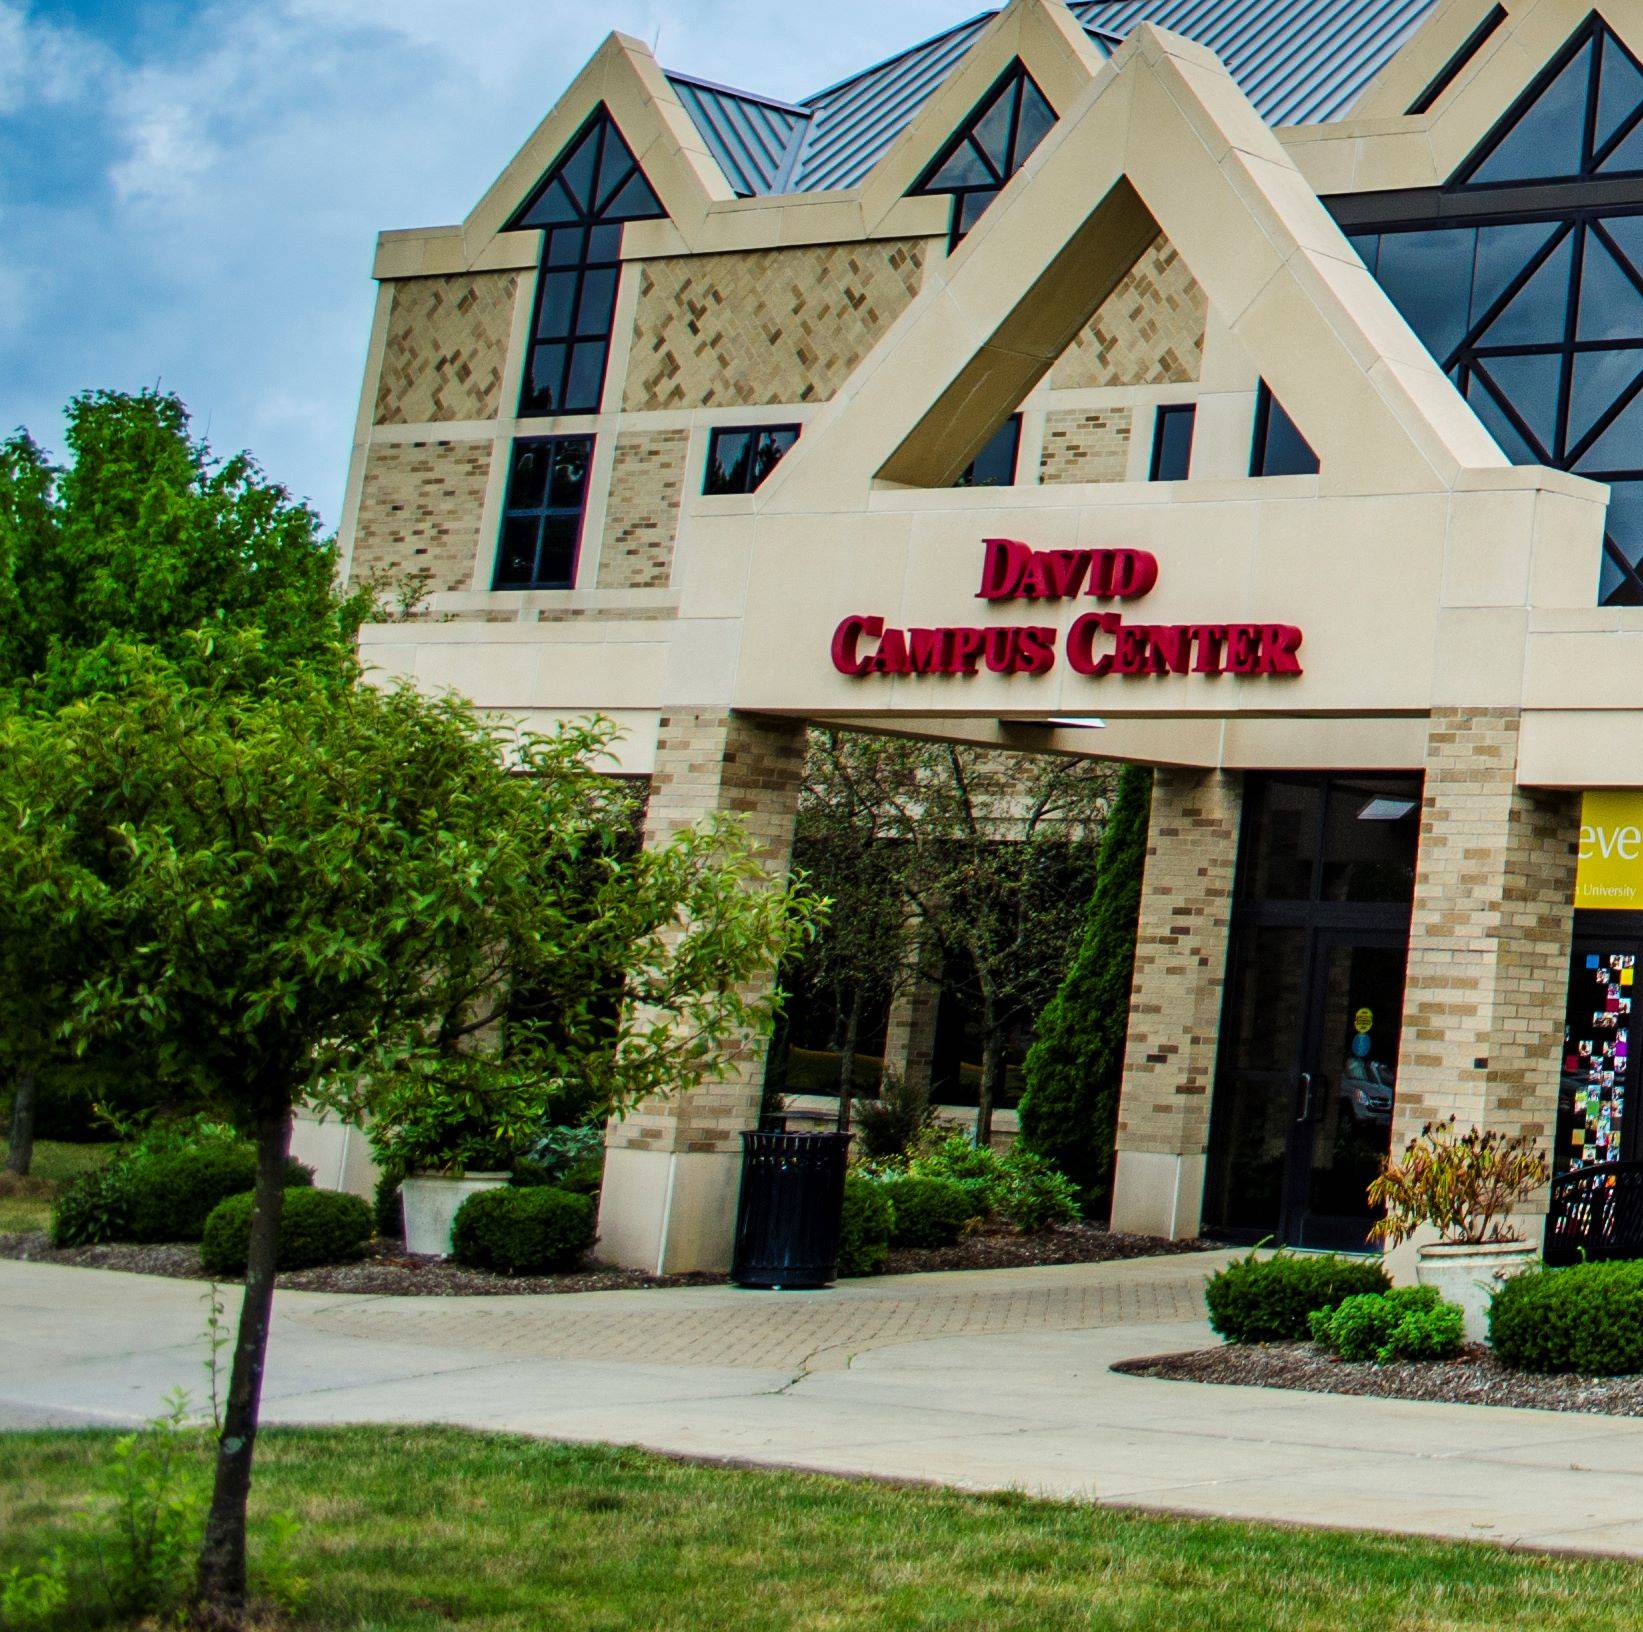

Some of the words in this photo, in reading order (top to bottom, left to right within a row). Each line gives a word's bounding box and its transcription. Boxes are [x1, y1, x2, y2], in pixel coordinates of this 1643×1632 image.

[975, 538, 1159, 600] DAVID
[832, 615, 1058, 674] CAMPUS
[1066, 612, 1304, 675] CENTER
[1583, 883, 1637, 900] University
